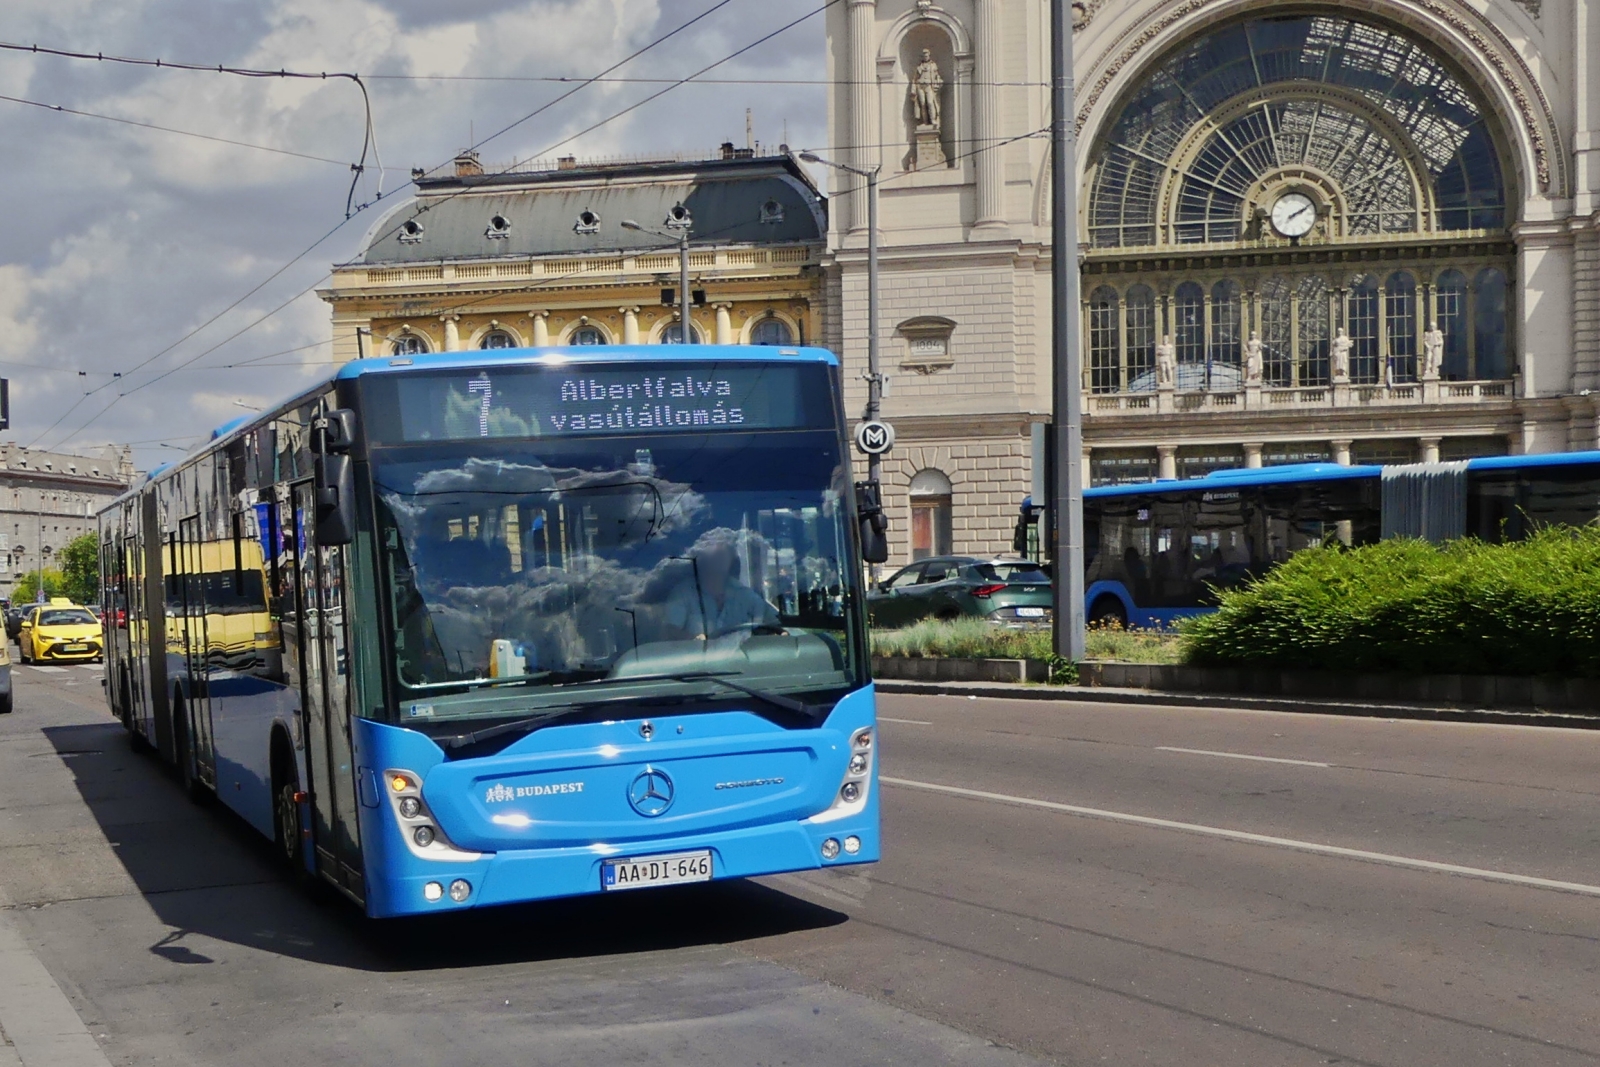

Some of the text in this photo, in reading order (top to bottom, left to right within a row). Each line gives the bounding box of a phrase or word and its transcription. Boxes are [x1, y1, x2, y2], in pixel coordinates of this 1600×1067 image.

[561, 376, 731, 401] Albertfalva
[468, 380, 491, 437] 7
[550, 400, 744, 430] vasútállomás
[866, 428, 883, 445] M
[516, 782, 584, 797] BUDAPEST
[618, 857, 708, 883] AA DI-646
